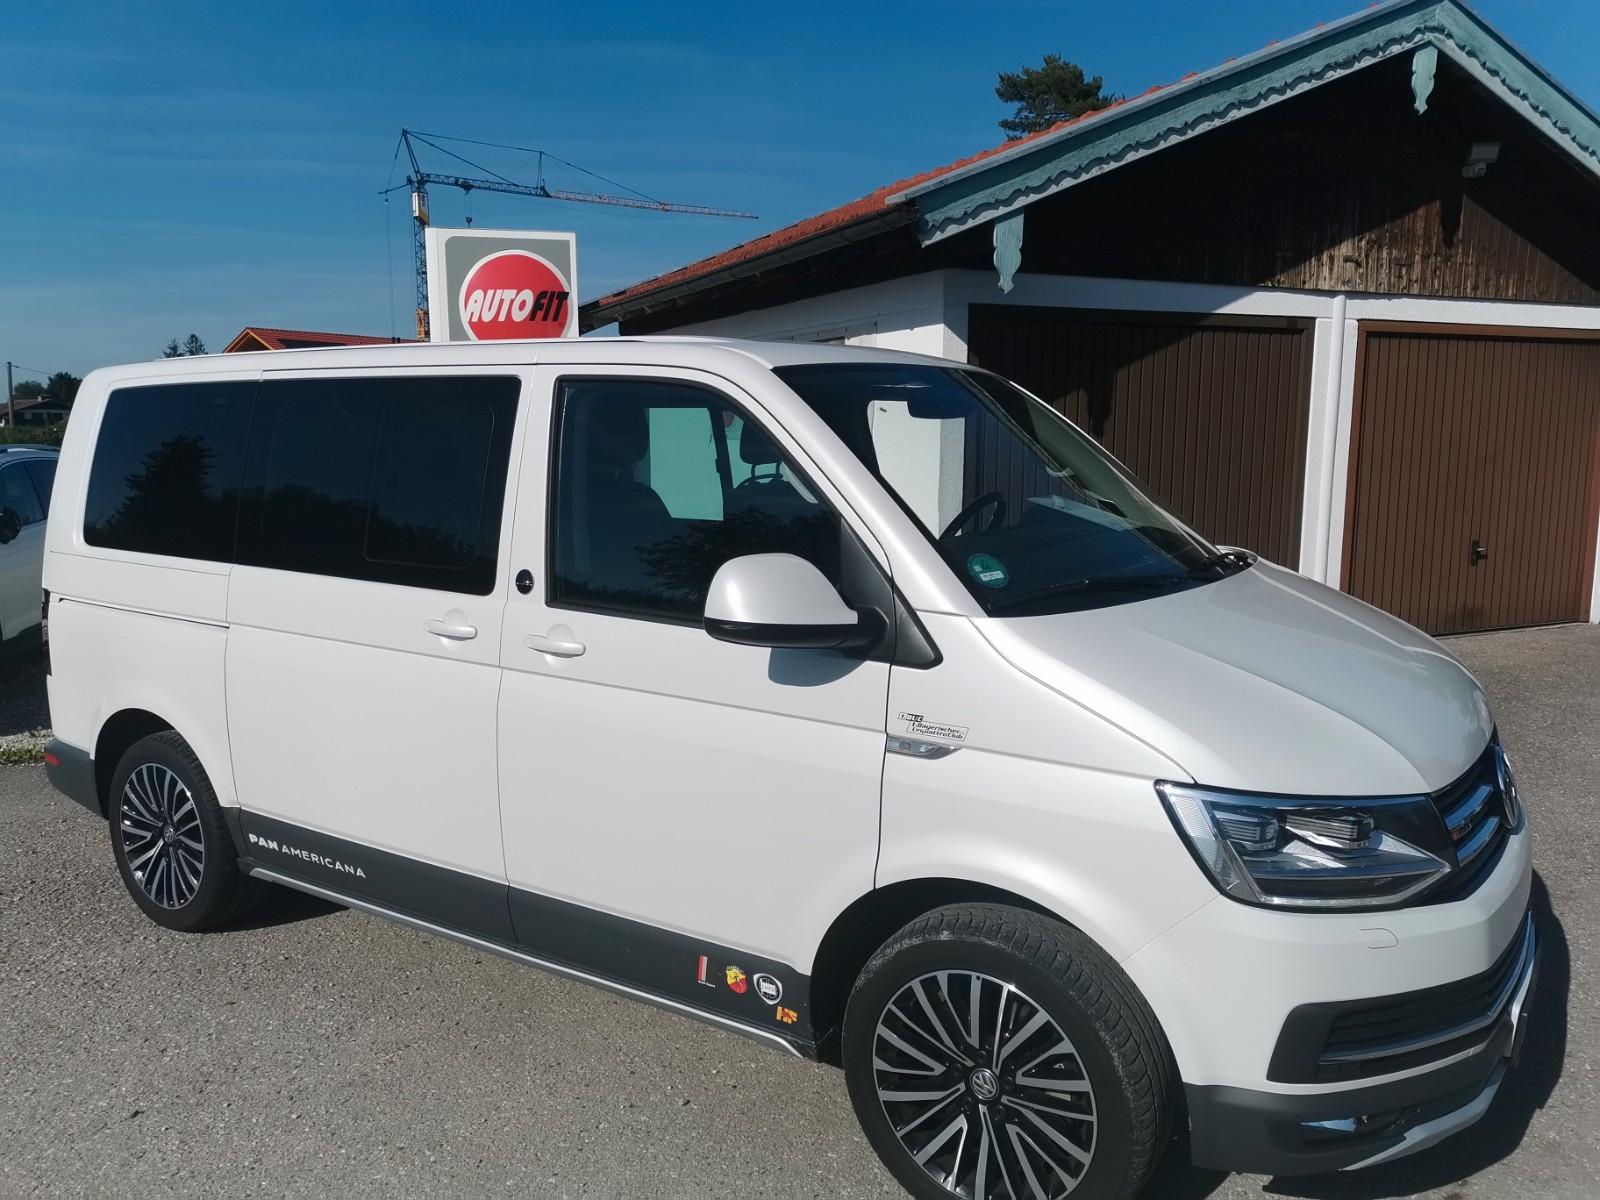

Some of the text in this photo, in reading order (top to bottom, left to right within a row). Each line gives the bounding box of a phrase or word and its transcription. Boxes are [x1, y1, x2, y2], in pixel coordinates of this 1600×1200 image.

[465, 288, 570, 323] AUTOFIT
[248, 833, 367, 879] PAN AMERICANA
